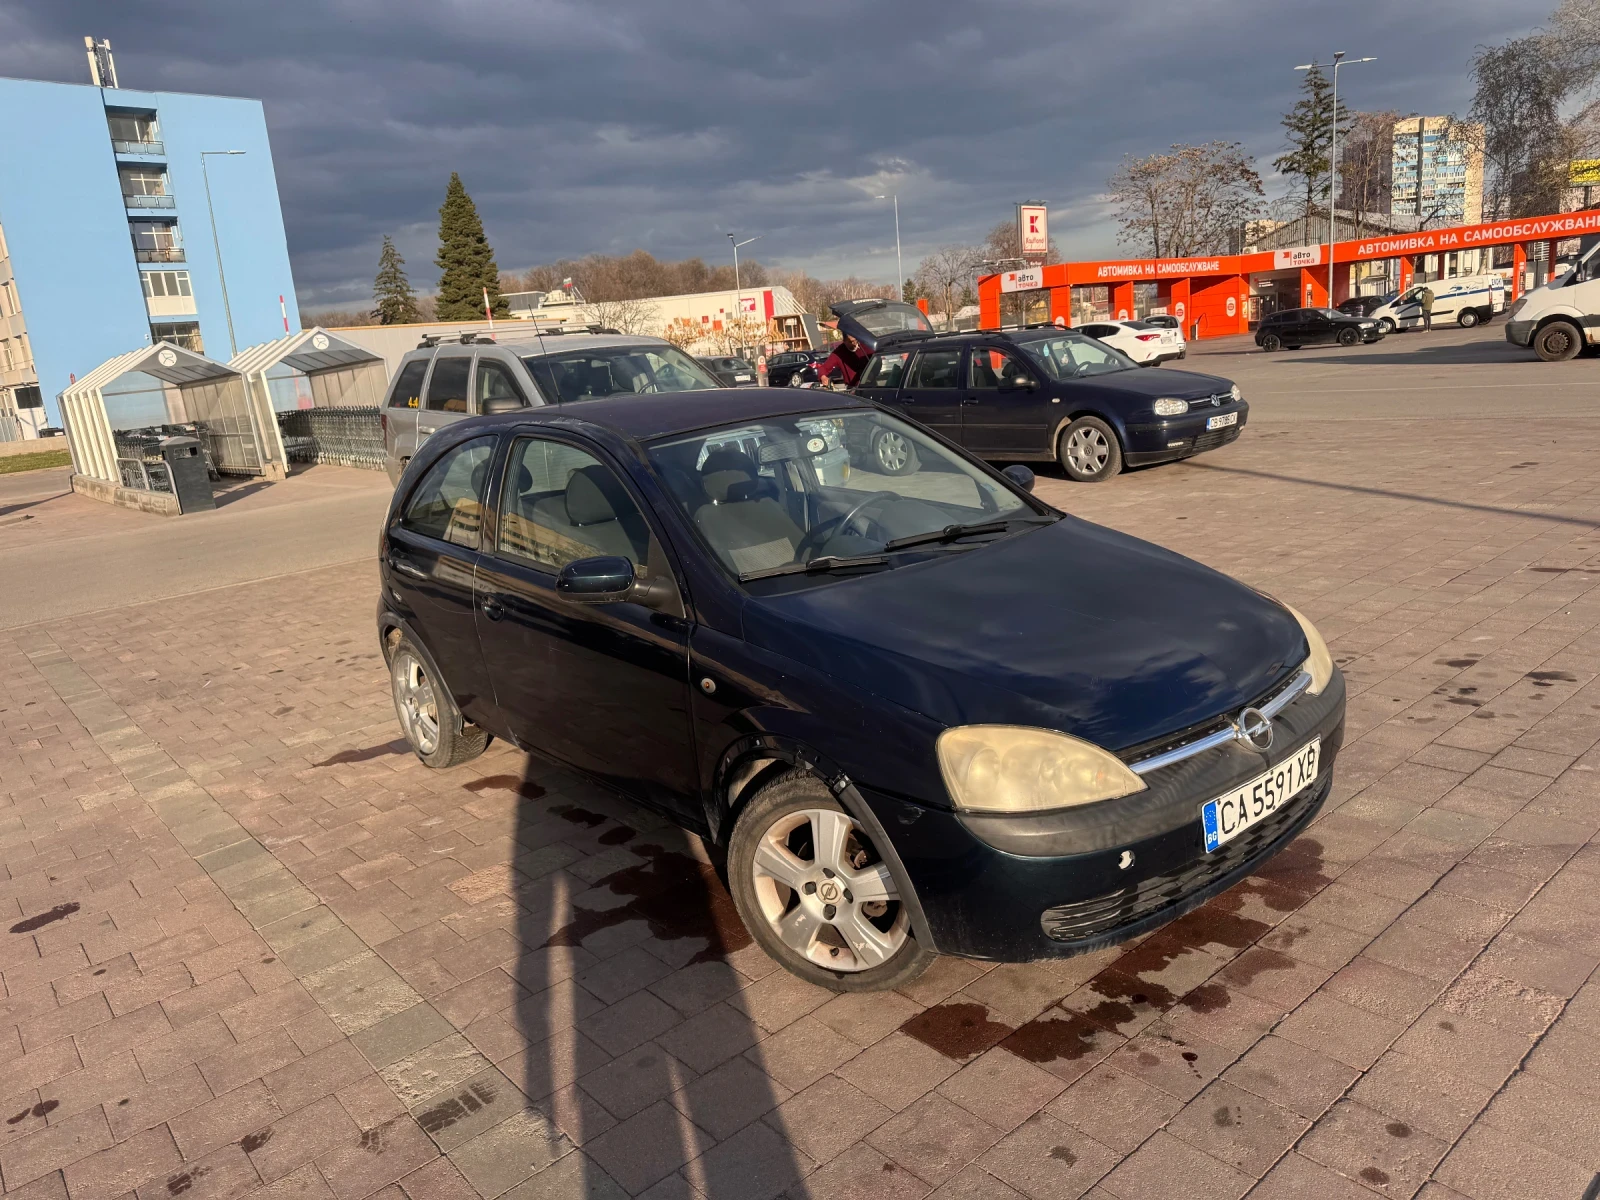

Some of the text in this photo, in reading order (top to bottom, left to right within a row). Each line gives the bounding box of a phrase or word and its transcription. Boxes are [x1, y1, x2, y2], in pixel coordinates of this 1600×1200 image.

[1030, 216, 1039, 233] K
[1026, 237, 1045, 245] Kaufland
[1358, 236, 1435, 255] АВТОМИВКА
[1440, 233, 1459, 245] НА
[1098, 261, 1220, 277] АВТОМИВКА НА САМООБСЛУЖВАНЕ
[1293, 258, 1315, 266] точка
[1221, 749, 1315, 835] CA 5591 XB
[1207, 831, 1218, 844] BG
